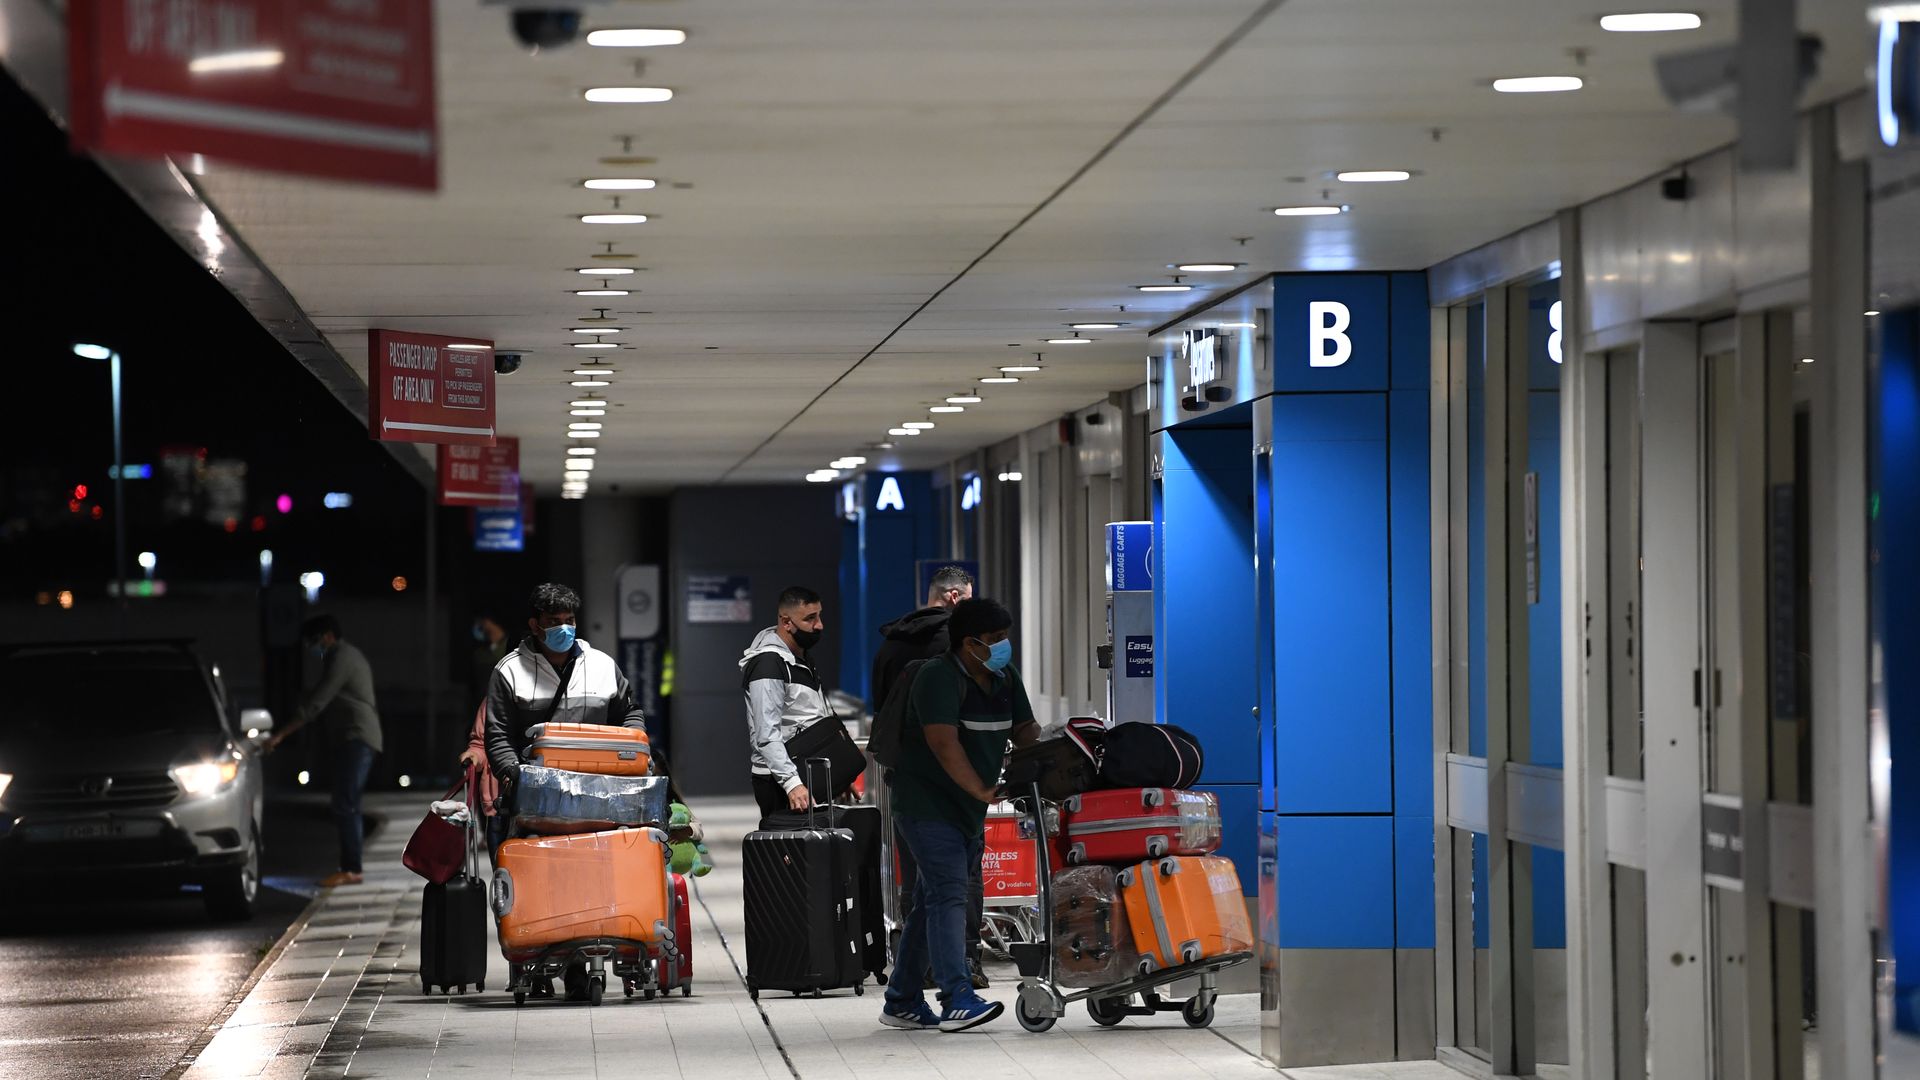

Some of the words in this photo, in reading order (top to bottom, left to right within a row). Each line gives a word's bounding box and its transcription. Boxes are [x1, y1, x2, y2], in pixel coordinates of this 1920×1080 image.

[1309, 301, 1352, 367] B
[389, 342, 421, 369] PASSENGER
[422, 346, 437, 371] DROP
[393, 375, 404, 400] OFF
[404, 377, 420, 402] AREA
[420, 378, 435, 403] ONLY
[876, 476, 905, 511] A
[1116, 525, 1125, 550] CARTS
[1117, 552, 1125, 589] BAGGAGE
[1128, 641, 1153, 653] Easy
[1129, 657, 1153, 665] Luggag
[981, 860, 1000, 869] ATA
[982, 851, 1018, 861] NDLESS
[1007, 880, 1032, 888] vodafone
